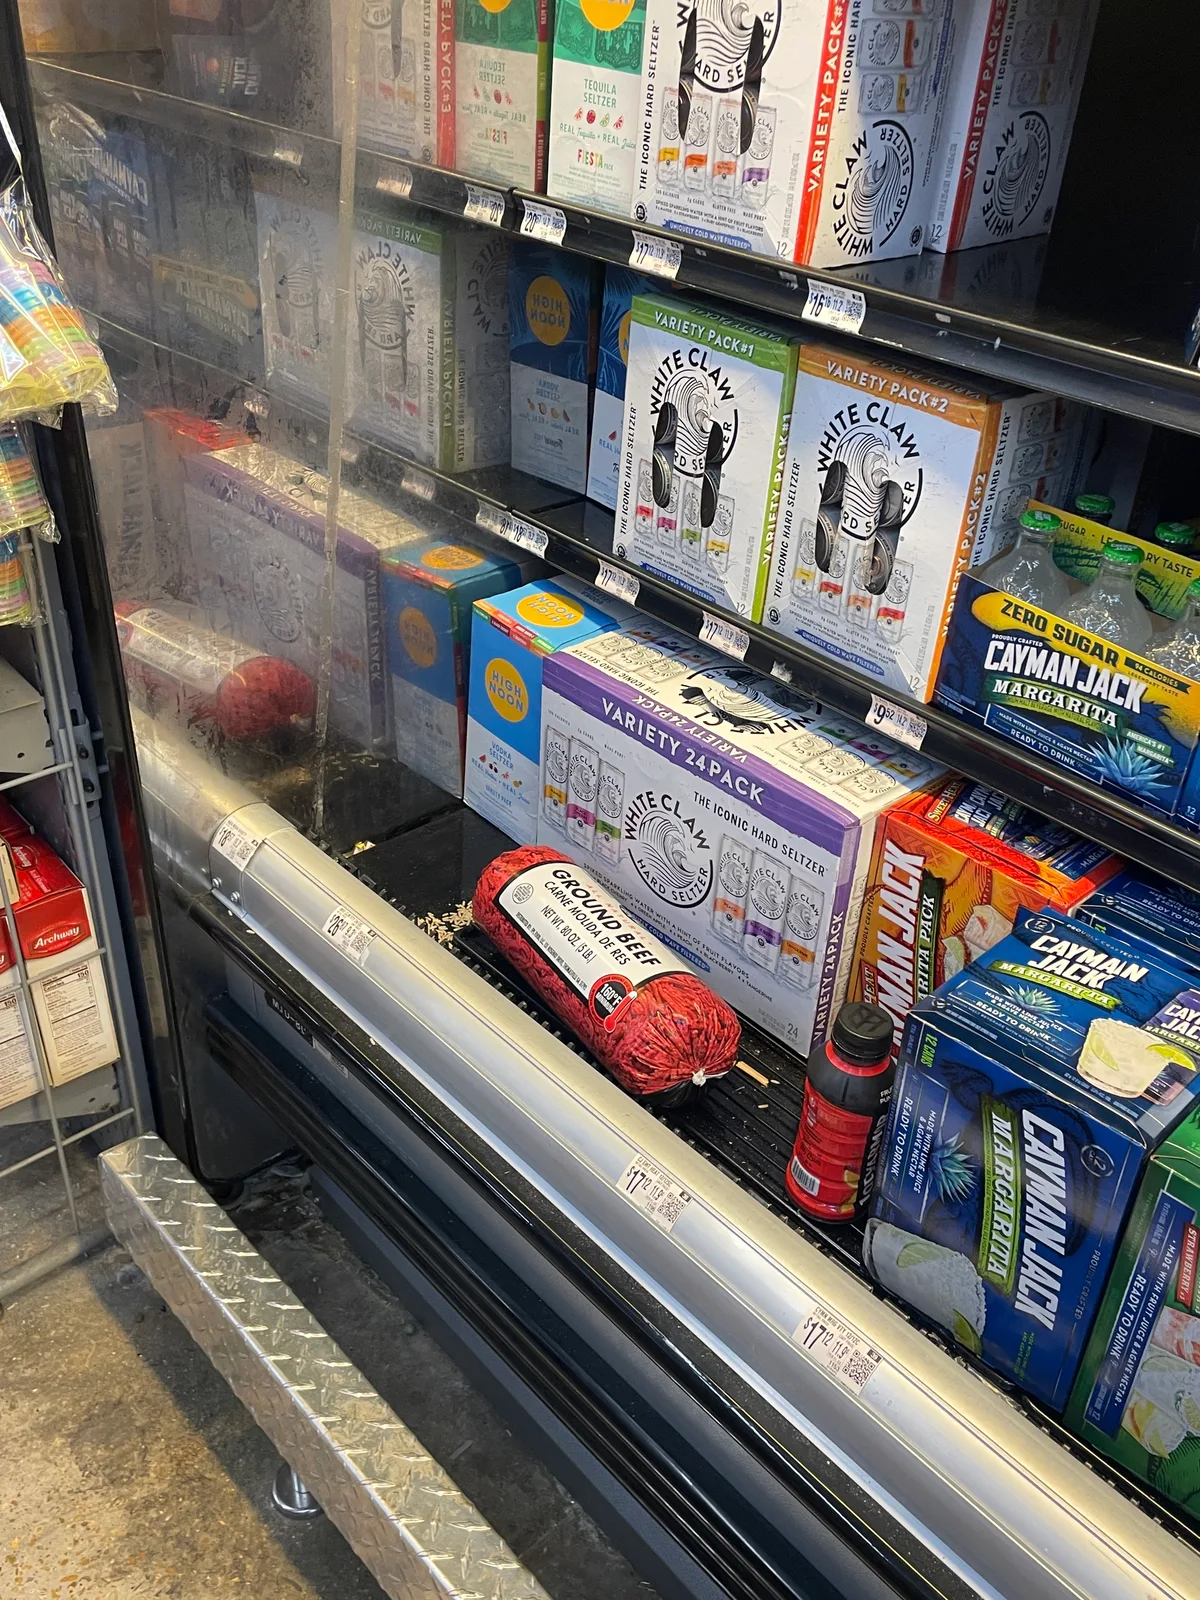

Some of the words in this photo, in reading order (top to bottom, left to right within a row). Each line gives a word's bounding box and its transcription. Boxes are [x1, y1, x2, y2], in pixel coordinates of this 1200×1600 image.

[584, 79, 617, 95] TEQUILA
[584, 93, 617, 108] SELTZER
[645, 82, 655, 120] HARD
[560, 123, 575, 134] REAL
[603, 134, 619, 145] REAL
[642, 123, 652, 162] ICONIC
[808, 97, 831, 193] VARIETY
[879, 127, 911, 177] SELTZER
[964, 89, 989, 180] VARIETY
[577, 149, 603, 168] FIESTA
[832, 130, 868, 210] CLAW
[983, 121, 1015, 198] CLAW
[639, 172, 649, 190] THE
[886, 184, 910, 233] HARD
[983, 211, 1014, 238] WHITE
[669, 223, 694, 233] UNIQUELY
[695, 229, 708, 238] COLD
[710, 232, 723, 241] WAVE
[832, 214, 873, 258] WHITE
[654, 310, 705, 340] VARIETY
[708, 329, 755, 358] PACK#1
[649, 348, 685, 416] WHITE
[688, 347, 736, 401] CLAW
[826, 360, 887, 396] VARIETY
[889, 382, 950, 414] PACK#2
[770, 413, 792, 495] PACK#1
[817, 402, 860, 474] WHITE
[866, 402, 921, 461] CLAW
[626, 446, 634, 479] HARD
[622, 481, 631, 515] ICONIC
[960, 473, 987, 553] PACK#2
[978, 504, 992, 546] ICONIC
[988, 467, 1001, 502] HARD
[620, 517, 628, 535] THE
[763, 495, 780, 566] VARIETY
[783, 501, 793, 536] HARD
[778, 538, 789, 574] ICONIC
[1059, 522, 1086, 536] SUGAR
[1162, 555, 1194, 578] TASTE
[774, 576, 784, 598] THE
[528, 600, 562, 624] HIGH
[536, 594, 578, 622] NOON
[802, 632, 826, 647] UNIQUELY
[827, 644, 841, 654] COLD
[841, 650, 856, 663] WAVE
[992, 634, 1017, 642] PROUDLY
[1018, 637, 1043, 647] CRAFTED
[1000, 599, 1048, 632] ZERO
[1053, 621, 1120, 668] SUGAR
[492, 669, 523, 698] HIGH
[984, 640, 1080, 688] CAYMAN
[1078, 660, 1150, 715] JACK
[1128, 670, 1160, 689] LEGENDARY
[1161, 686, 1179, 697] TASTE
[1134, 662, 1144, 671] 94
[1144, 666, 1179, 688] CALORIES
[489, 681, 524, 714] NOON
[632, 695, 688, 728] 24PACK
[993, 680, 1118, 729] MARGARITA
[600, 700, 681, 757] VARIETY
[687, 726, 748, 763] VARIETY
[489, 748, 514, 772] SELTZER
[491, 740, 513, 761] VODKA
[1010, 729, 1036, 745] READY
[1038, 742, 1048, 752] TO
[1050, 748, 1075, 766] DRINK
[927, 798, 950, 822] SWEET
[942, 781, 962, 802] HEAT
[1187, 805, 1197, 816] 12
[625, 790, 658, 841] WHITE
[661, 793, 711, 851] CLAW
[694, 790, 712, 810] THE
[715, 801, 750, 833] ICONIC
[752, 823, 779, 850] HARD
[12, 846, 32, 868] Archway
[636, 858, 667, 896] HARD
[671, 866, 708, 902] SELTZER
[540, 904, 553, 920] NET
[551, 916, 564, 929] WT.
[560, 922, 571, 936] 80
[566, 932, 578, 946] OZ.
[575, 941, 585, 955] (5
[543, 881, 575, 909] CARNE
[568, 904, 602, 939] MOLIDA
[597, 936, 612, 950] DE
[609, 948, 631, 966] RES
[552, 868, 622, 931] GROUND
[615, 933, 662, 968] BEEF
[859, 926, 870, 957] PROUDLY
[865, 895, 875, 925] CRAFTED
[34, 925, 80, 948] Archway
[77, 969, 90, 978] 150
[812, 973, 835, 1042] VARIETY
[824, 912, 844, 971] 24PACK
[1027, 955, 1116, 990] JACK
[1030, 935, 1150, 983] CAYMAN
[598, 983, 623, 1006] 160°F
[1000, 961, 1109, 1005] MARGARITA
[4, 997, 17, 1008] 150
[787, 1023, 799, 1039] 24
[975, 1001, 1005, 1017] READY
[1006, 1016, 1018, 1026] TO
[1018, 1023, 1052, 1041] DRINK
[921, 1046, 936, 1068] CANS
[927, 1033, 938, 1046] 12
[899, 1096, 913, 1131] READY
[928, 1110, 937, 1129] MADE
[897, 1131, 907, 1145] TO
[925, 1129, 933, 1150] WITH
[891, 1145, 904, 1178] DRINK
[921, 1149, 929, 1168] LIME
[913, 1167, 925, 1194] JUICE
[988, 1111, 1014, 1282] MARGARITA
[1021, 1109, 1067, 1256] CAYMAN
[1090, 1249, 1102, 1285] PROUDLY
[1181, 1226, 1198, 1293] STRAWBERRY
[1014, 1238, 1063, 1331] JACK
[1073, 1284, 1091, 1321] CRAFTED
[1127, 1273, 1146, 1312] READY
[815, 1307, 827, 1318] CYMN
[827, 1315, 837, 1327] MRG
[837, 1323, 845, 1334] VTY
[1121, 1312, 1133, 1331] TO
[1109, 1332, 1127, 1366] DRINK
